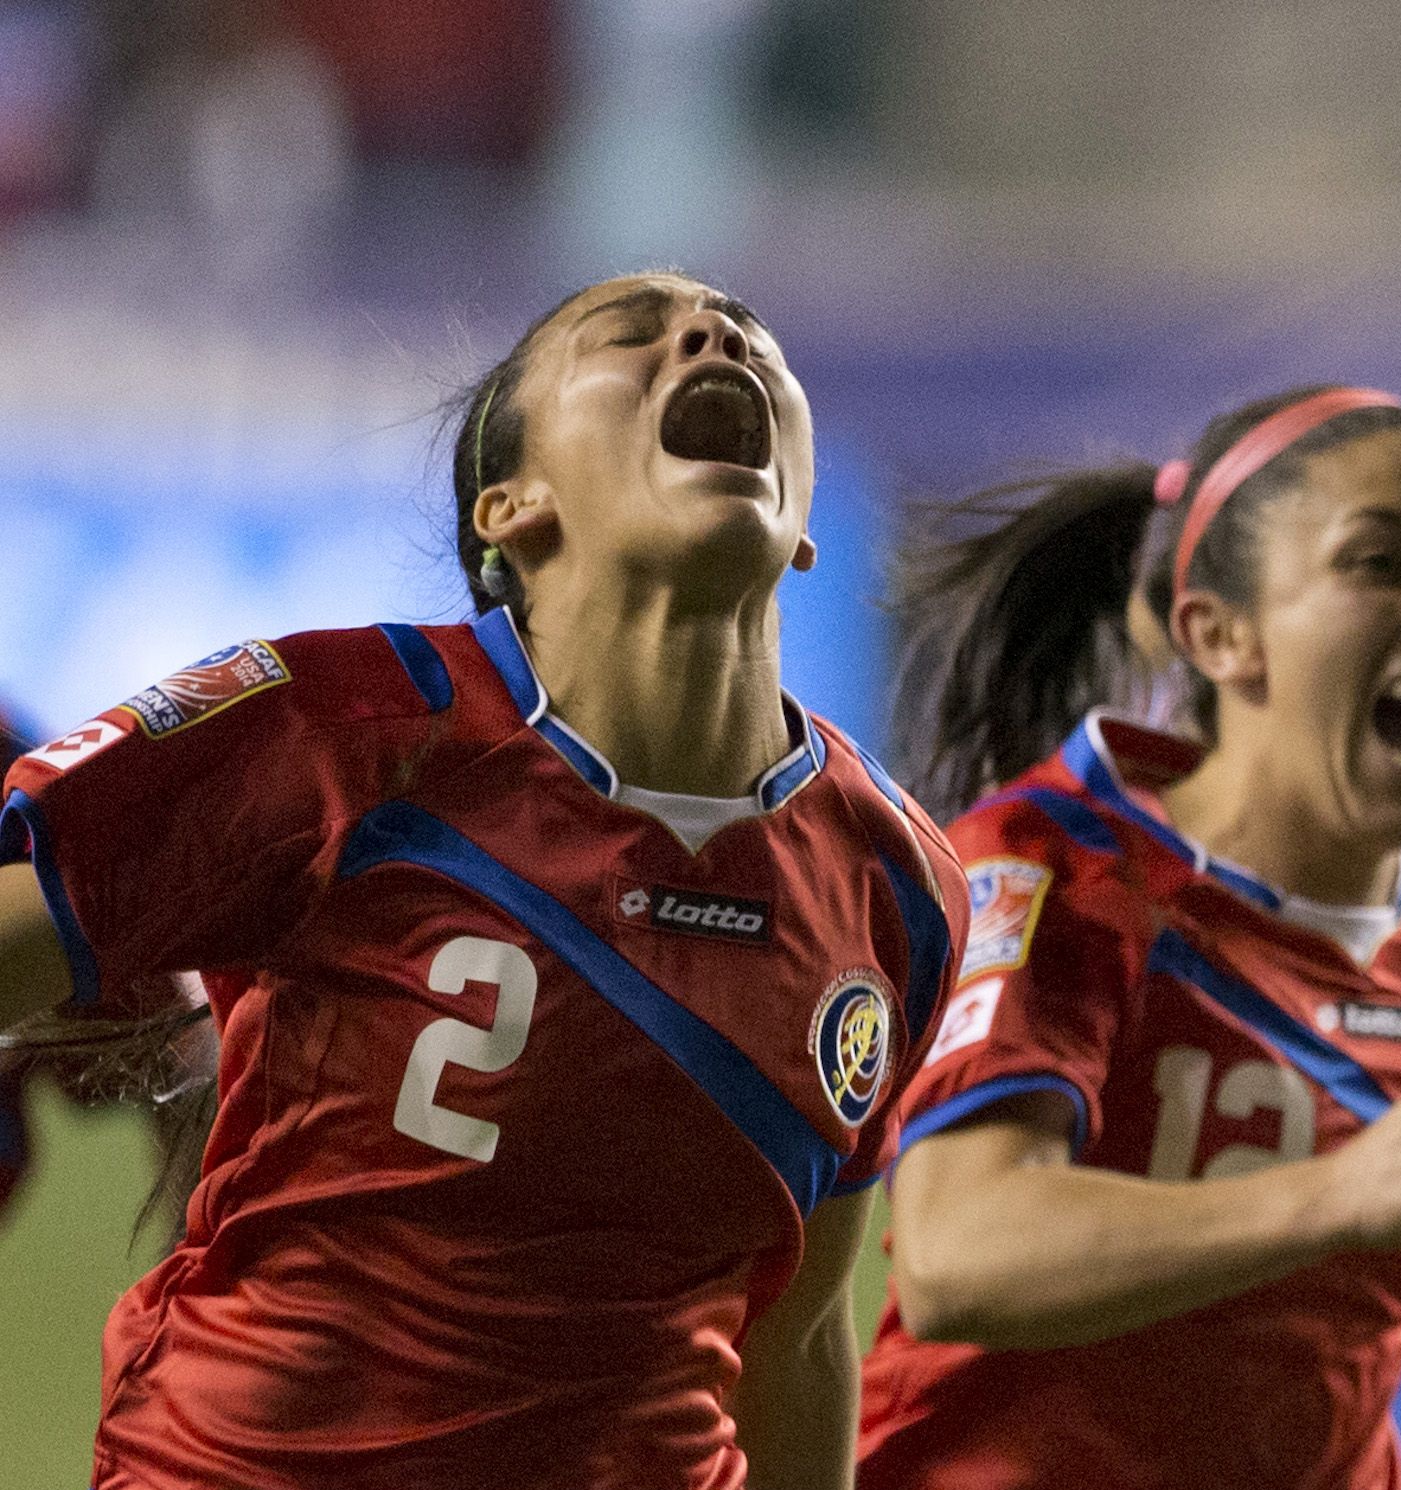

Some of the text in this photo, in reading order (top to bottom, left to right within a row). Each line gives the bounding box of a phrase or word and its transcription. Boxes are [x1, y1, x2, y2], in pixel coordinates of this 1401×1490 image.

[230, 663, 254, 688] 2014
[239, 656, 265, 685] USA
[657, 896, 764, 932] lotto
[393, 936, 538, 1163] 2
